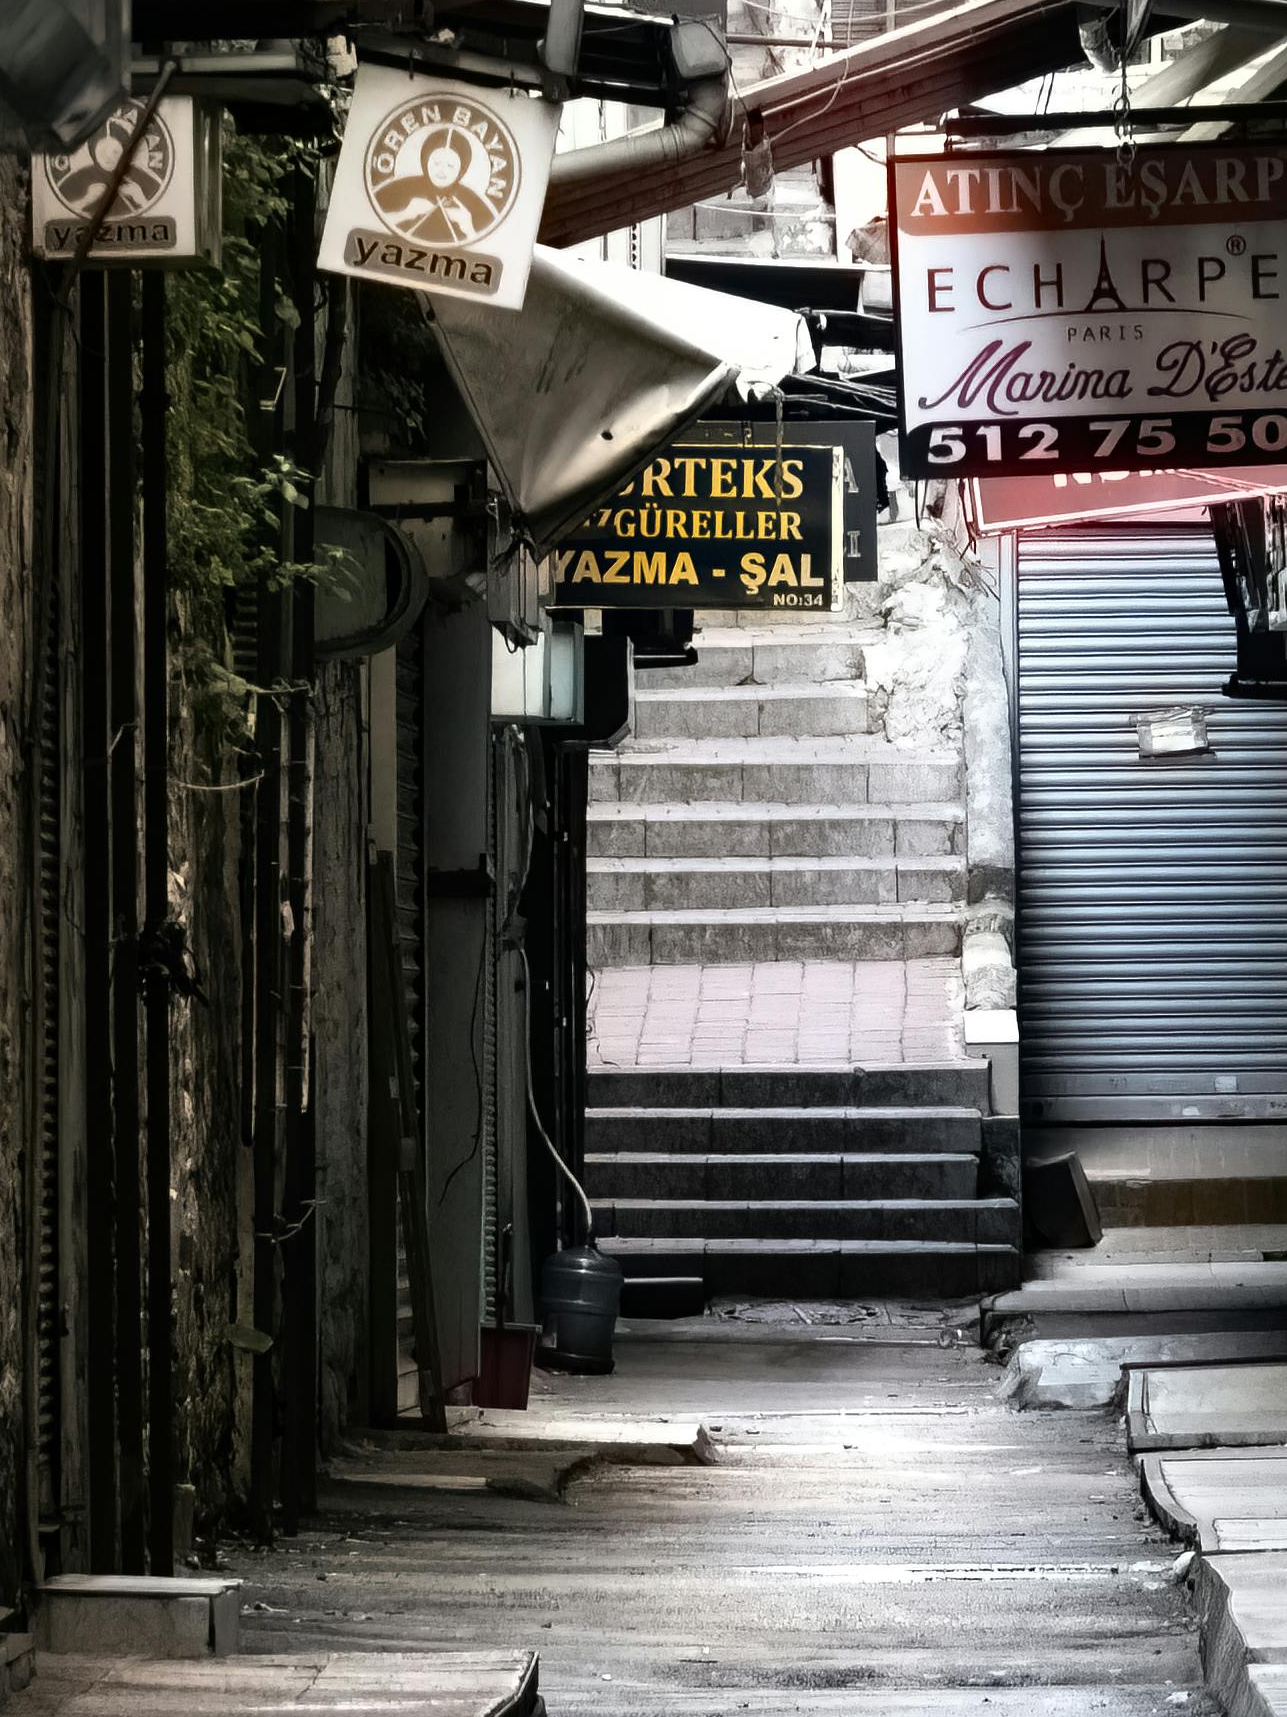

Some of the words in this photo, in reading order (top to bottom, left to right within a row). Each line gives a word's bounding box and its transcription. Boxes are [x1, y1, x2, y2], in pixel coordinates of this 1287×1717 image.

[910, 165, 1086, 222] ATINÇ
[1104, 155, 1286, 220] EŞARP
[352, 236, 494, 285] yazma
[1067, 323, 1144, 343] PARIS
[918, 338, 1133, 416] Marina
[927, 421, 1062, 466] 512
[1087, 418, 1178, 459] 75
[617, 456, 805, 500] RTEKS
[554, 547, 700, 586] YAZMA
[738, 551, 825, 596] ŞAL
